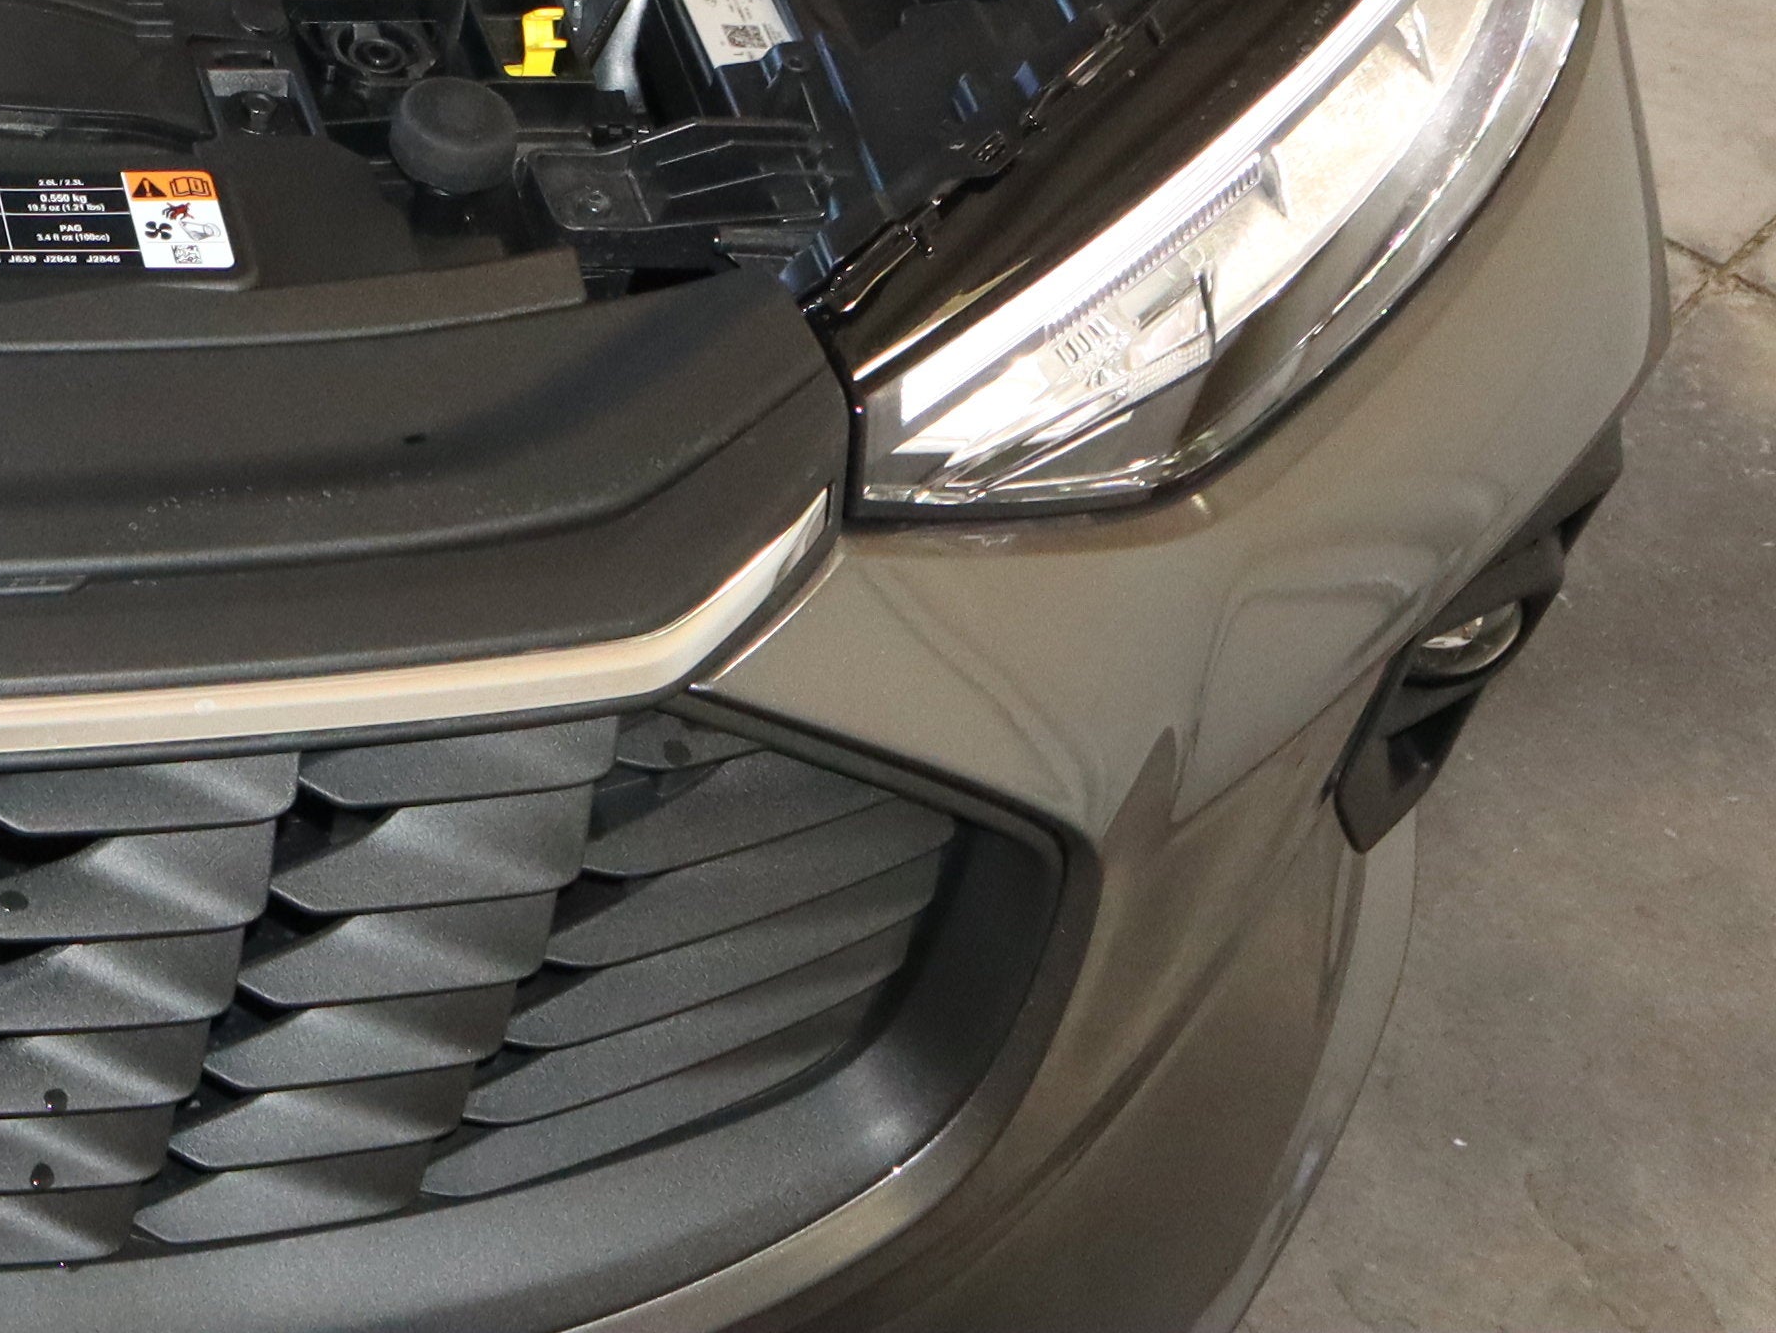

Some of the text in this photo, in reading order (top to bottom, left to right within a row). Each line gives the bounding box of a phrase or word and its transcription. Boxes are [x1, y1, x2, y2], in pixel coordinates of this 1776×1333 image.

[39, 194, 88, 205] 0.550 kg
[59, 225, 83, 233] PAG
[36, 234, 52, 242] 3.4
[8, 255, 37, 264] J639
